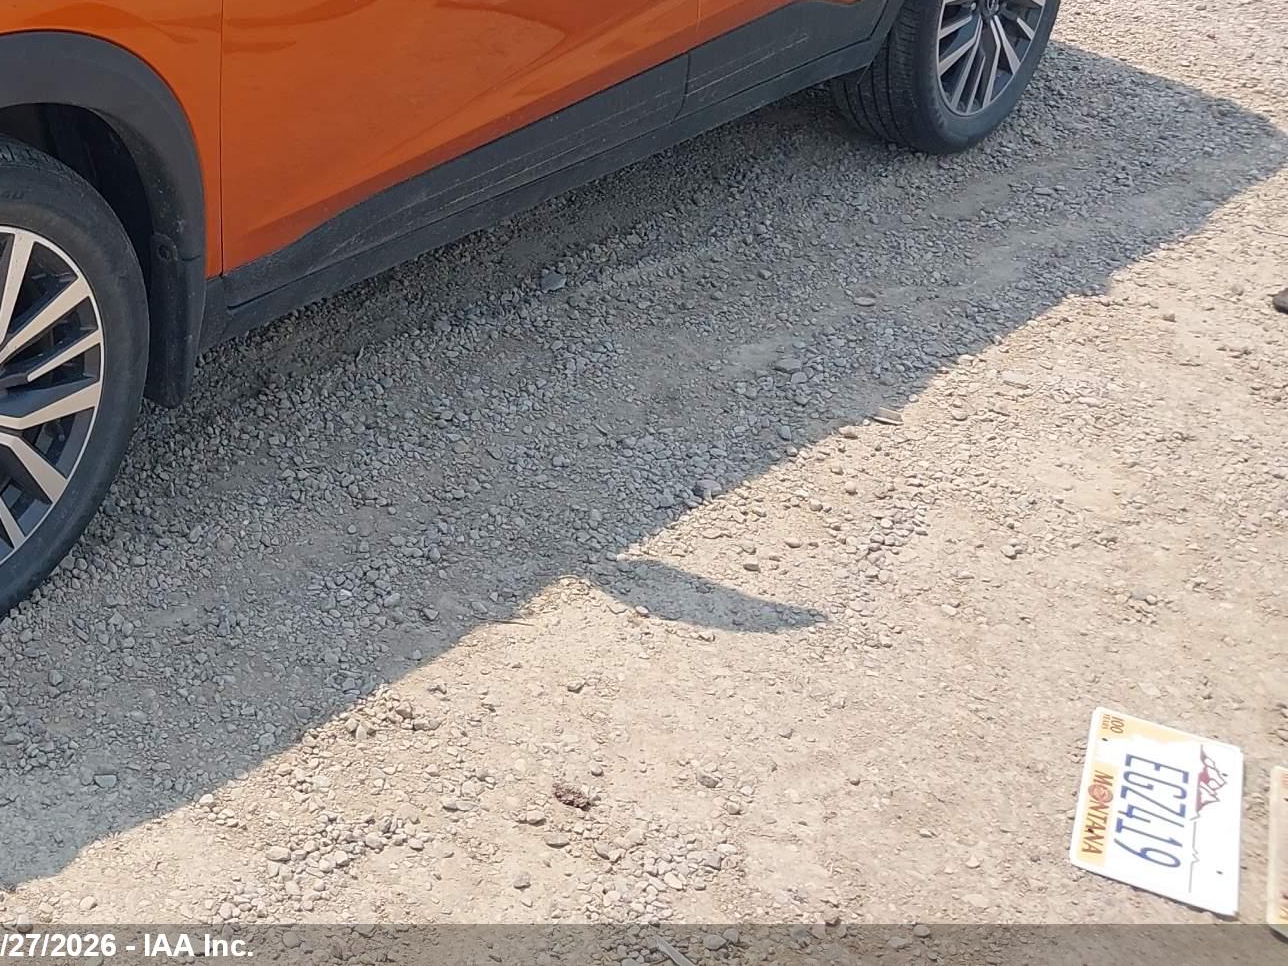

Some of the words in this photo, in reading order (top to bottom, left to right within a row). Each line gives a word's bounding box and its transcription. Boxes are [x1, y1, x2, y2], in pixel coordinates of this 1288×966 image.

[1109, 715, 1125, 734] 100
[1081, 769, 1114, 855] MONTANA
[1113, 753, 1190, 868] EGZ419
